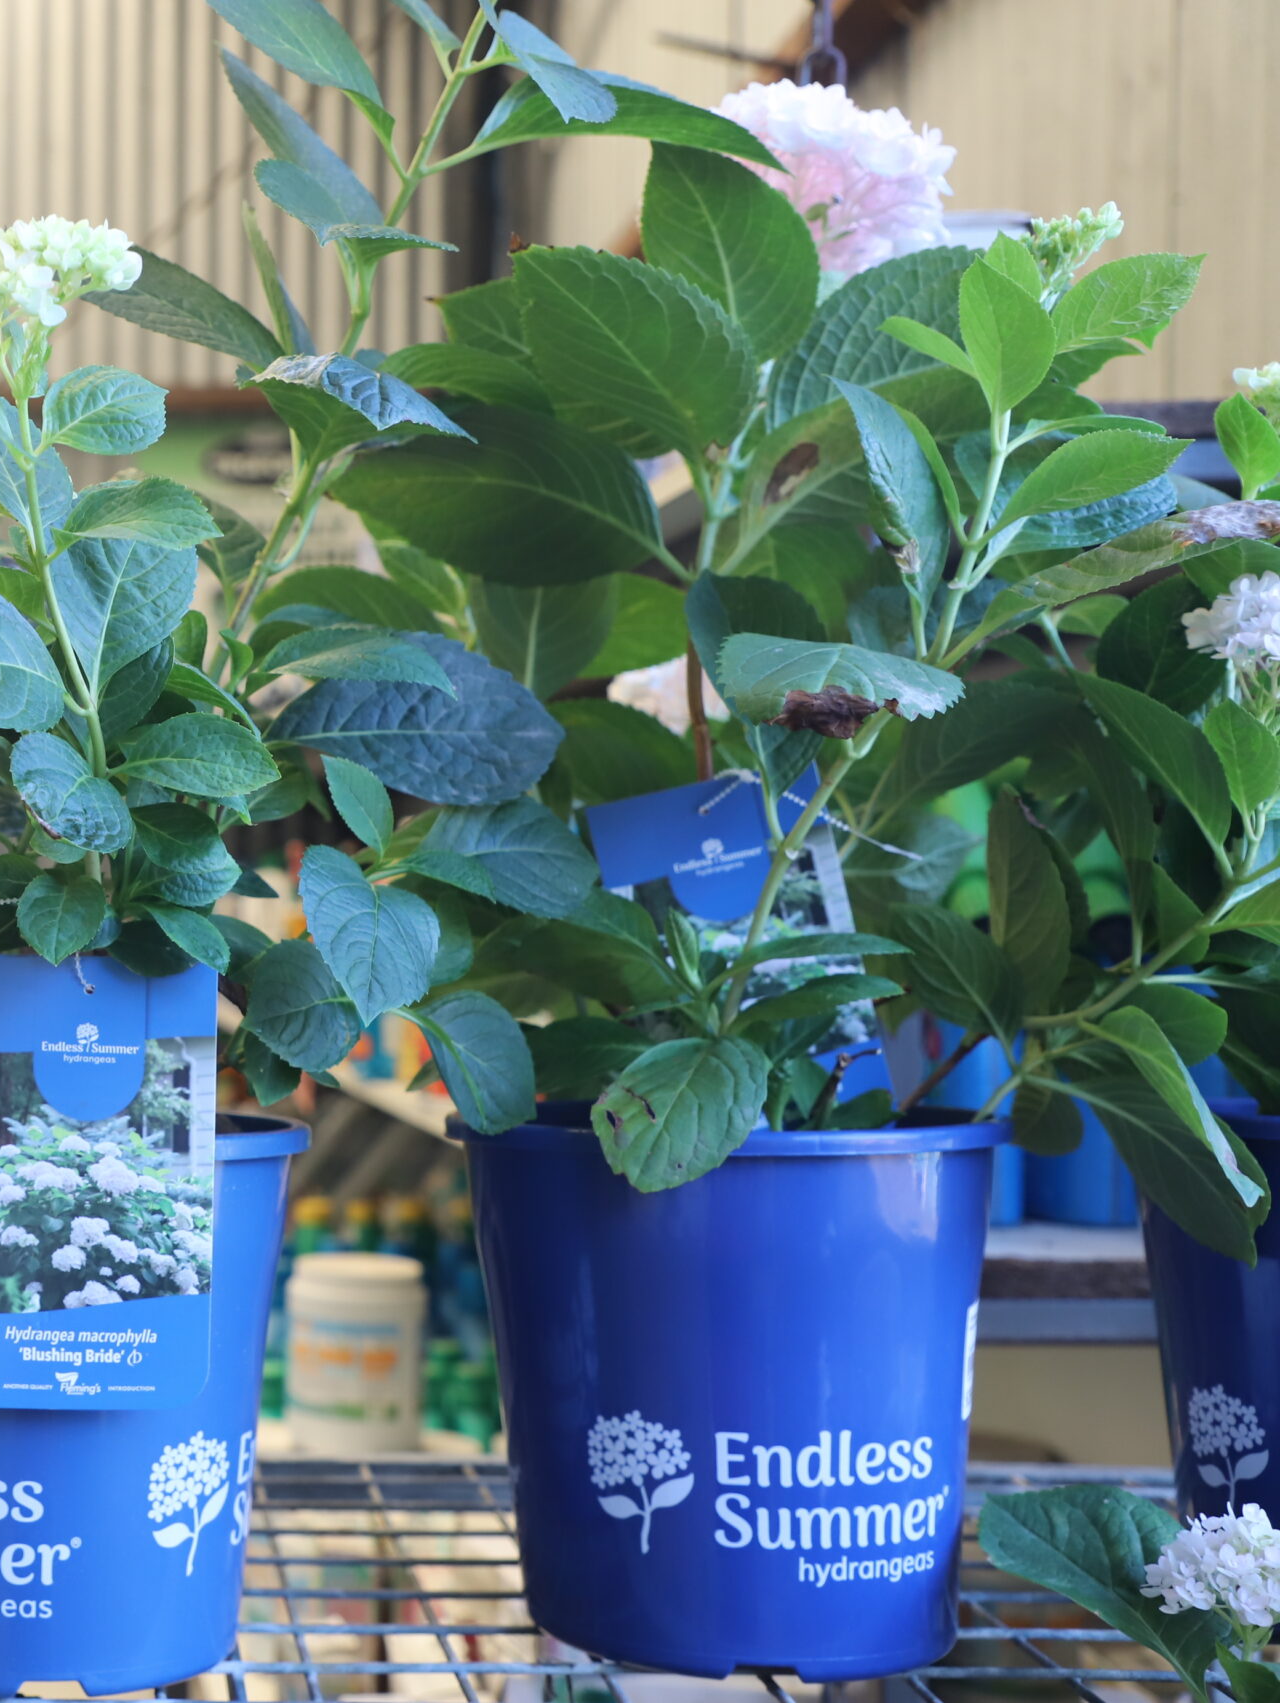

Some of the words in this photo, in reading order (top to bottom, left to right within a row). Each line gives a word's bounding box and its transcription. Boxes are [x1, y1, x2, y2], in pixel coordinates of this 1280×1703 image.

[41, 1040, 83, 1053] Endless
[91, 1042, 139, 1055] Summer
[63, 1053, 116, 1065] hydrangeas
[4, 1326, 75, 1345] Hydrangea
[78, 1328, 158, 1347] macrophylla
[59, 1381, 102, 1396] Fleming's
[714, 1429, 933, 1489] Endless
[798, 1550, 935, 1588] hydrangeas
